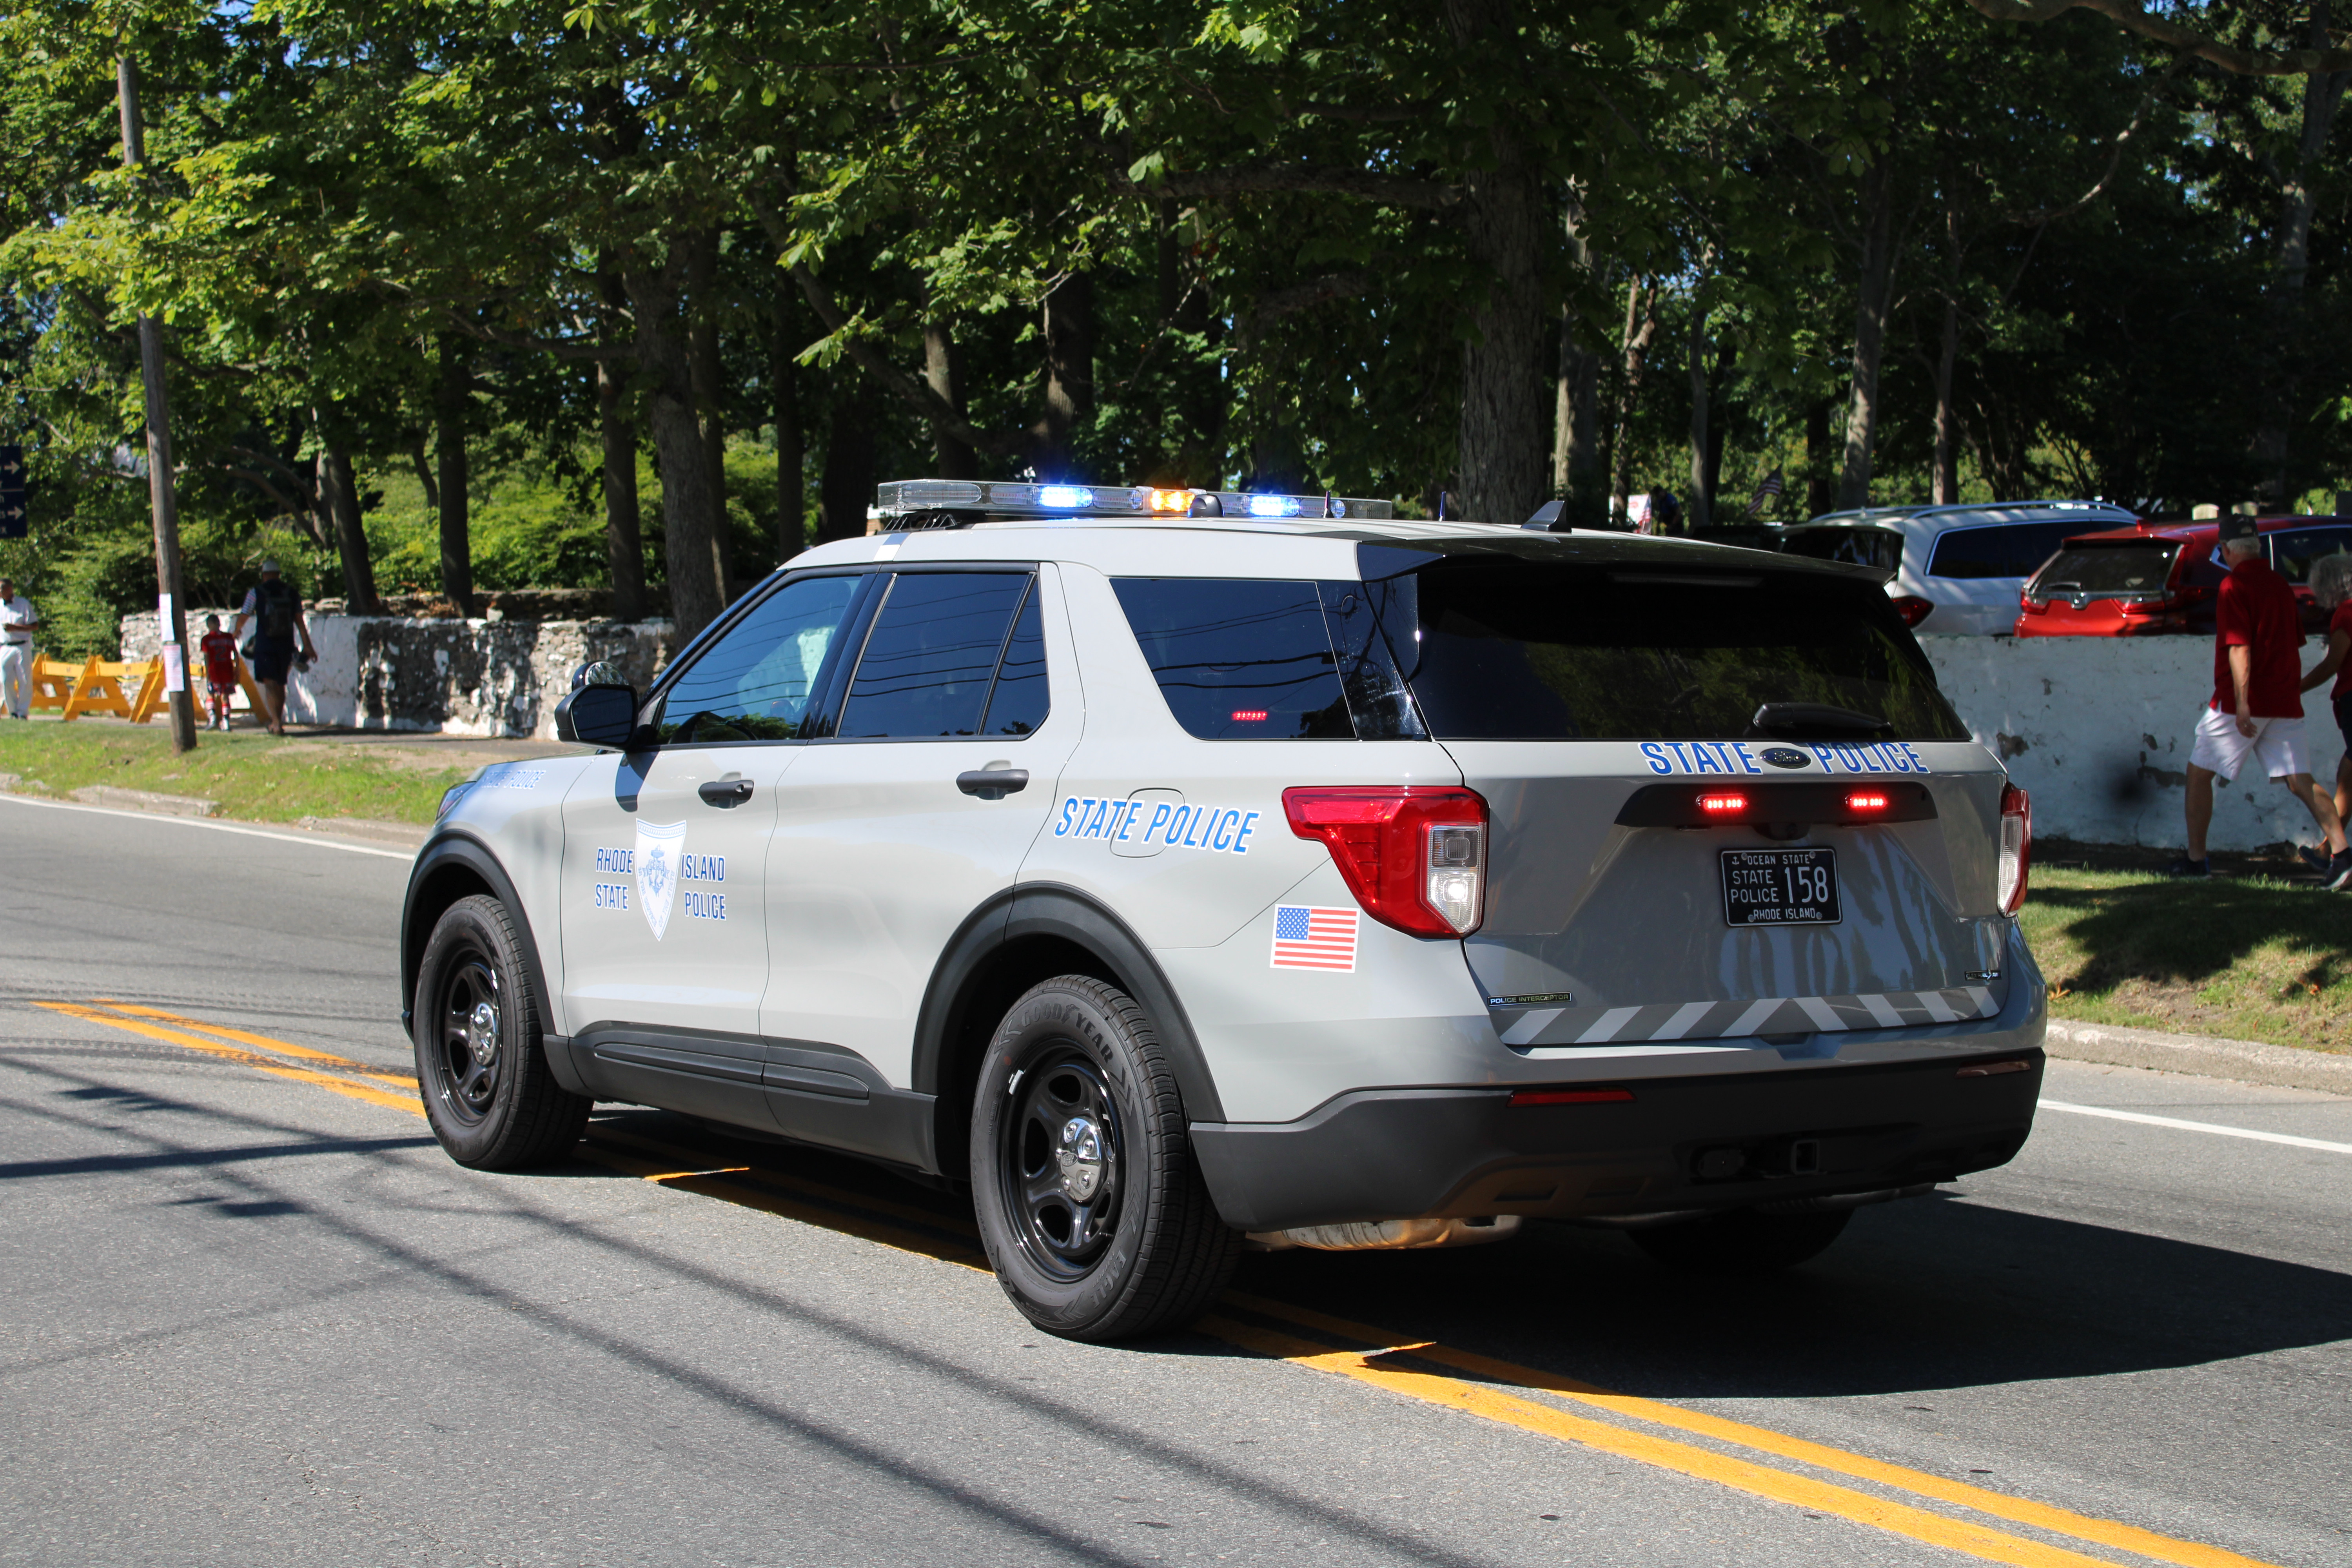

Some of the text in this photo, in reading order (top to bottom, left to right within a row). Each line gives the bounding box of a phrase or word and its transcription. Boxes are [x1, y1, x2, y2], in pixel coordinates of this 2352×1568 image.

[215, 646, 226, 661] 2
[1638, 742, 1931, 775] STATE POLICE
[1054, 795, 1262, 855] STATE POLICE
[596, 847, 726, 883] RHODE ISLAND
[1747, 854, 1810, 865] OCEAN STATE
[1732, 869, 1774, 885] STATE
[1784, 866, 1828, 904] 158
[595, 882, 726, 921] STATE POLICE
[1731, 887, 1780, 904] POLICE
[1753, 907, 1815, 920] RHODE ISLAND
[1519, 994, 1568, 1002] INTERCEPTOR
[1091, 1250, 1127, 1308] EAGLE
